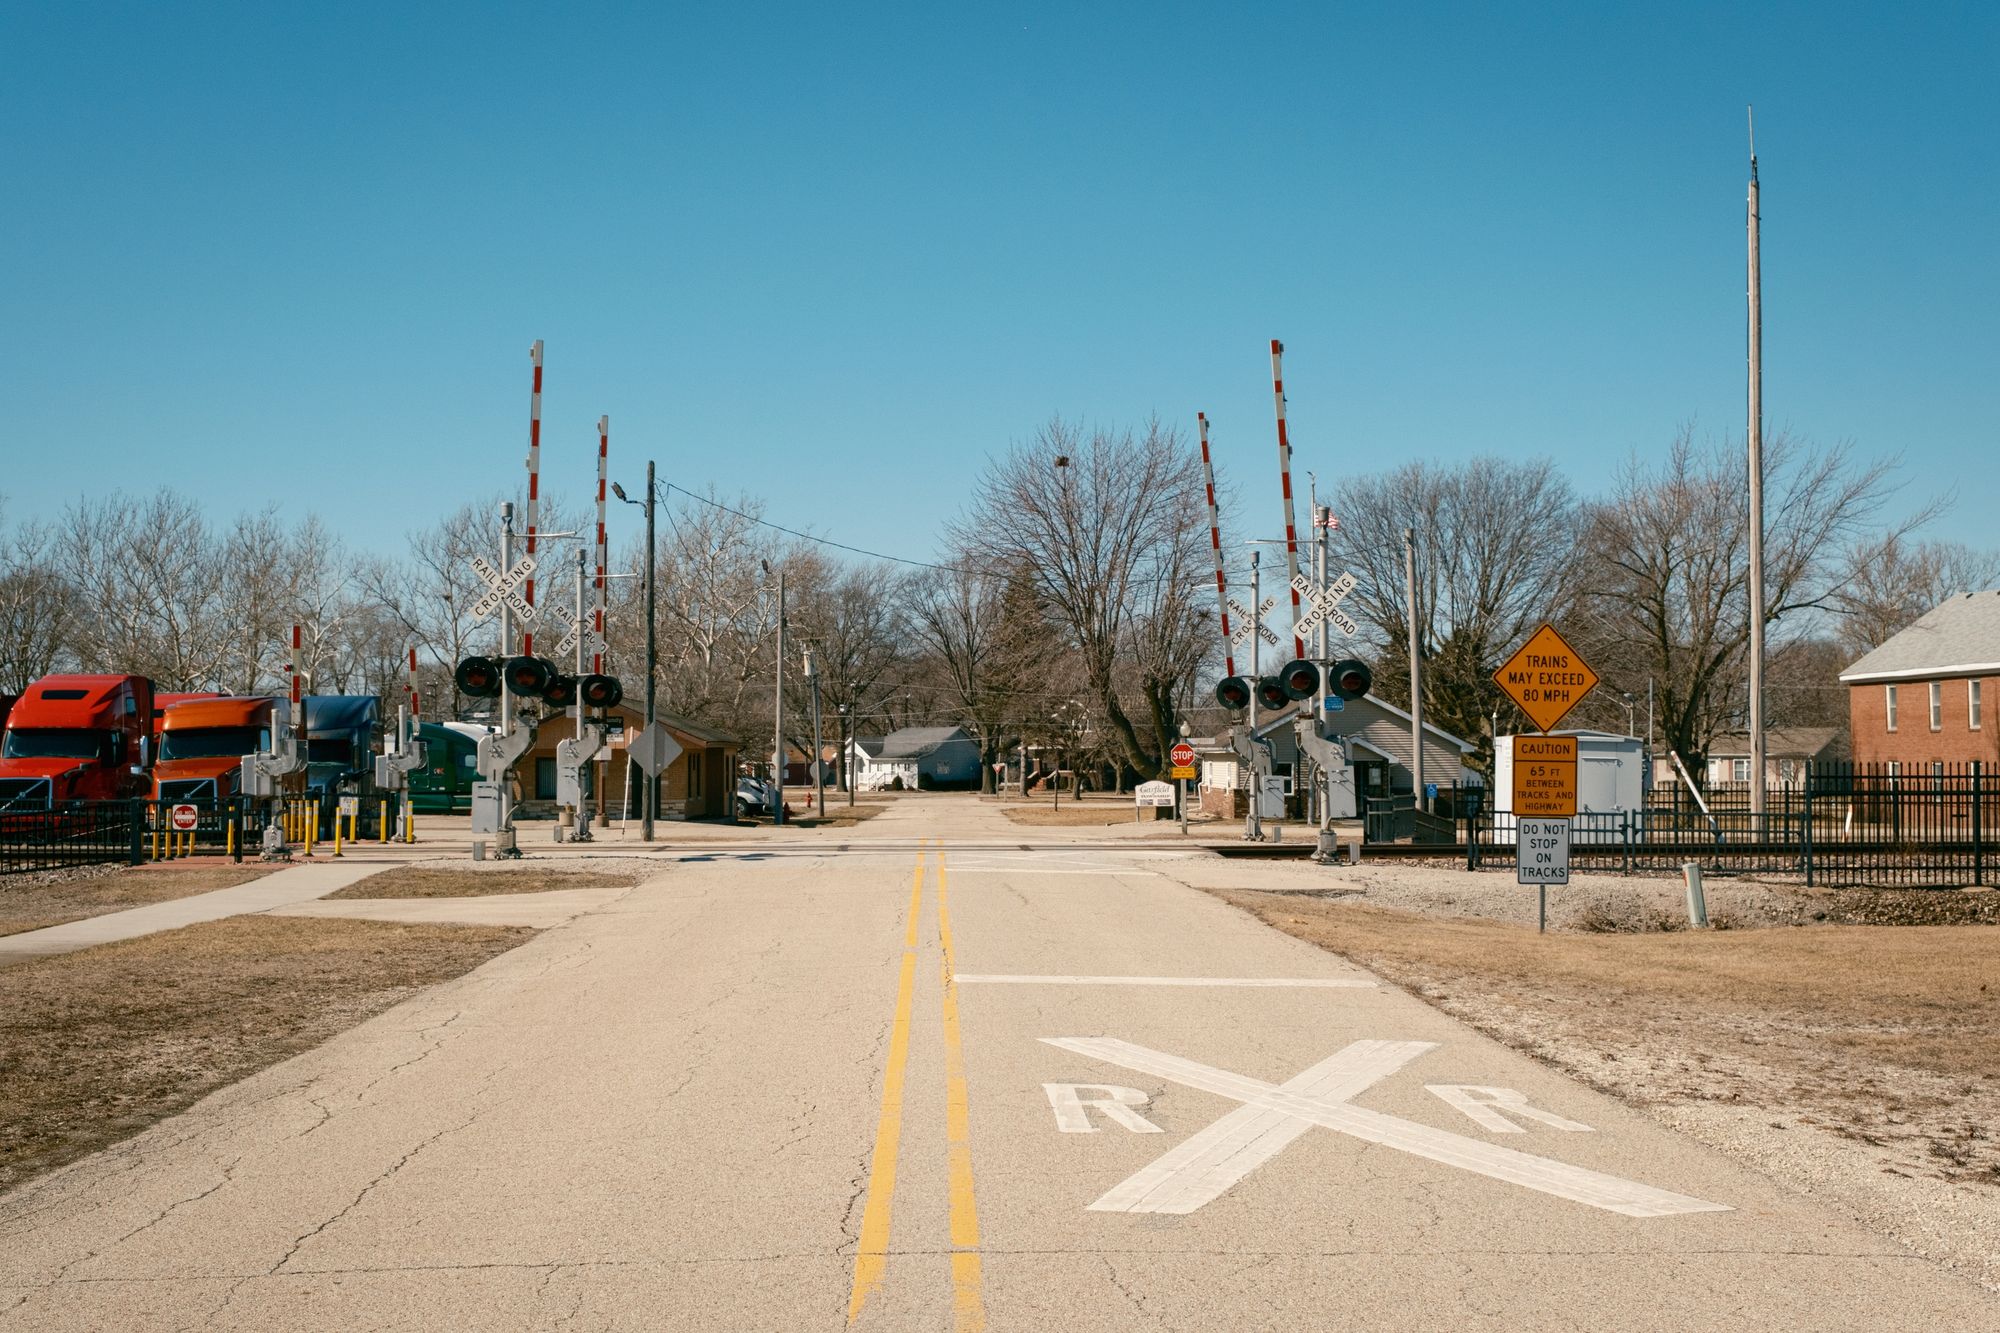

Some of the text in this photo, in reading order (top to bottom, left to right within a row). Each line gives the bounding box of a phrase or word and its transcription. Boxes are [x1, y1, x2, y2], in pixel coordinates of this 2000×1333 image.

[473, 558, 532, 618] RAIL ROAD
[475, 561, 531, 616] CROSSING
[1226, 600, 1246, 619] RAIL
[1294, 578, 1356, 634] RAIL ROAD
[1298, 578, 1351, 634] CROSSING
[556, 606, 606, 652] RAIL ROD
[560, 612, 596, 652] CROIN
[1526, 655, 1568, 668] TRAINS
[1508, 672, 1584, 686] MAY EXCEED
[1523, 689, 1570, 702] 80 MPH
[1521, 744, 1570, 754] CAUTION
[1173, 751, 1193, 760] STOP
[1530, 766, 1560, 776] 65 FT
[1140, 784, 1170, 793] Garfield
[1526, 780, 1564, 788] BETWEEN
[1517, 791, 1574, 799] TRACKS AND
[1525, 803, 1564, 811] HIGHWAY
[1523, 824, 1566, 835] DO NOT
[1530, 838, 1558, 849] STOP
[1536, 853, 1552, 863] ON
[1522, 867, 1565, 878] TRACKS
